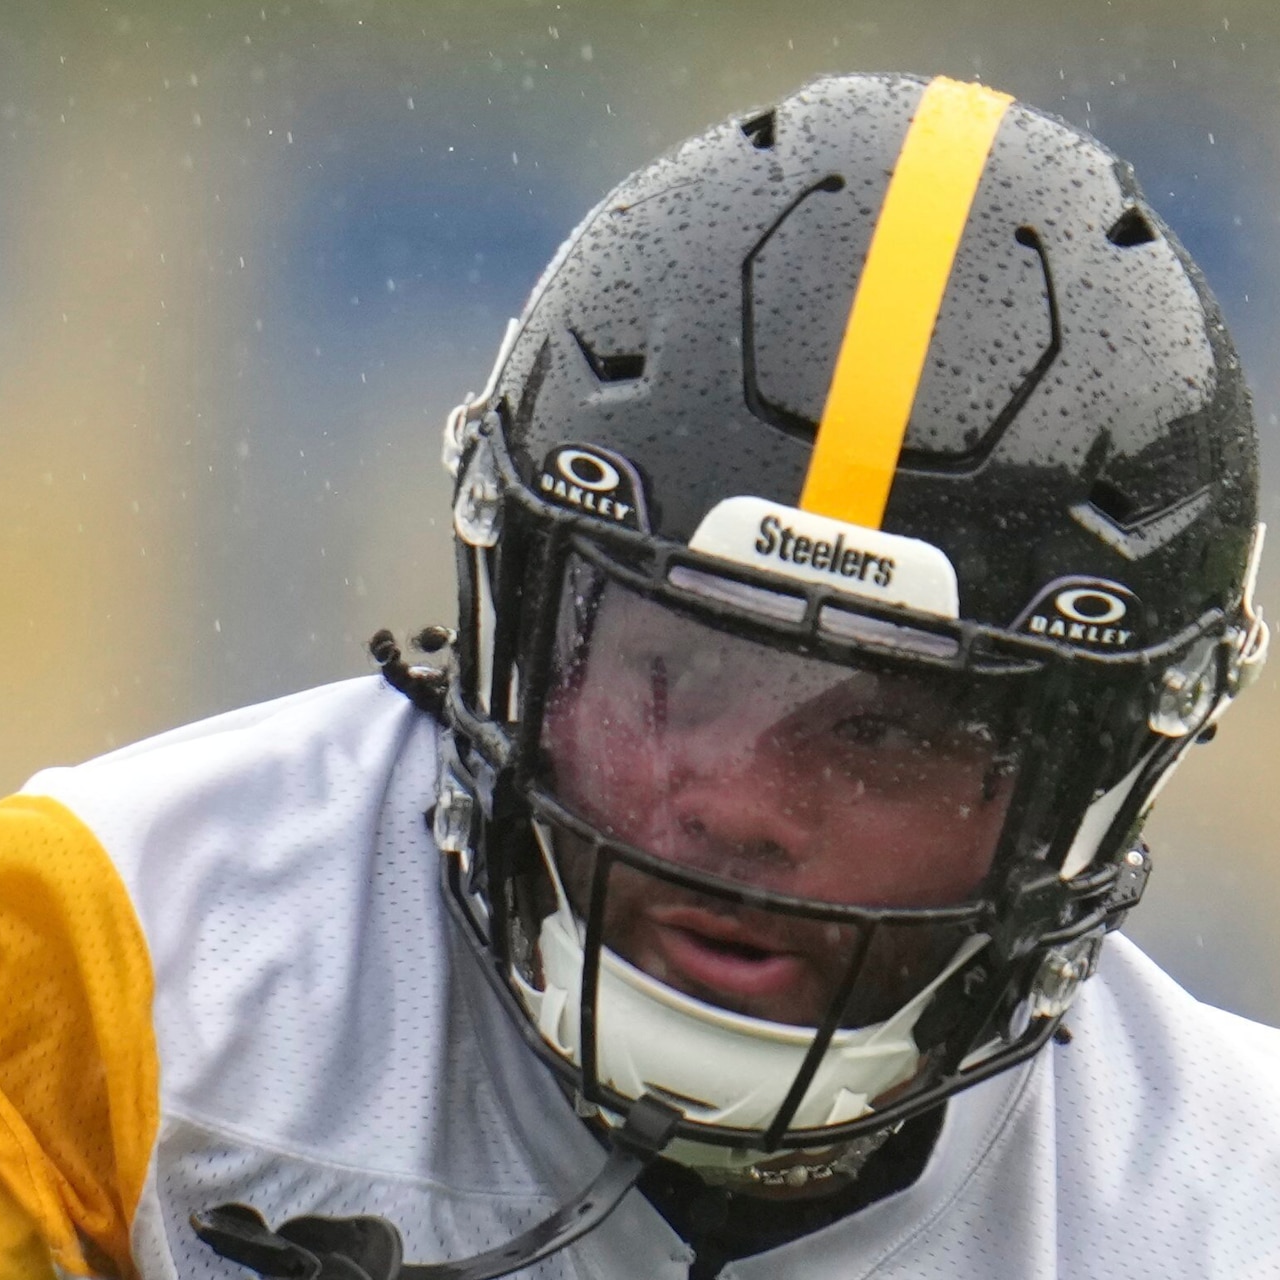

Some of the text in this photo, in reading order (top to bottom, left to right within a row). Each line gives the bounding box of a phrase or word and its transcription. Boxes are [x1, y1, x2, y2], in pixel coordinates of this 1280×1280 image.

[540, 473, 631, 521] OAKLEY
[754, 514, 896, 587] Steelers
[1029, 615, 1132, 645] OAKLEY
